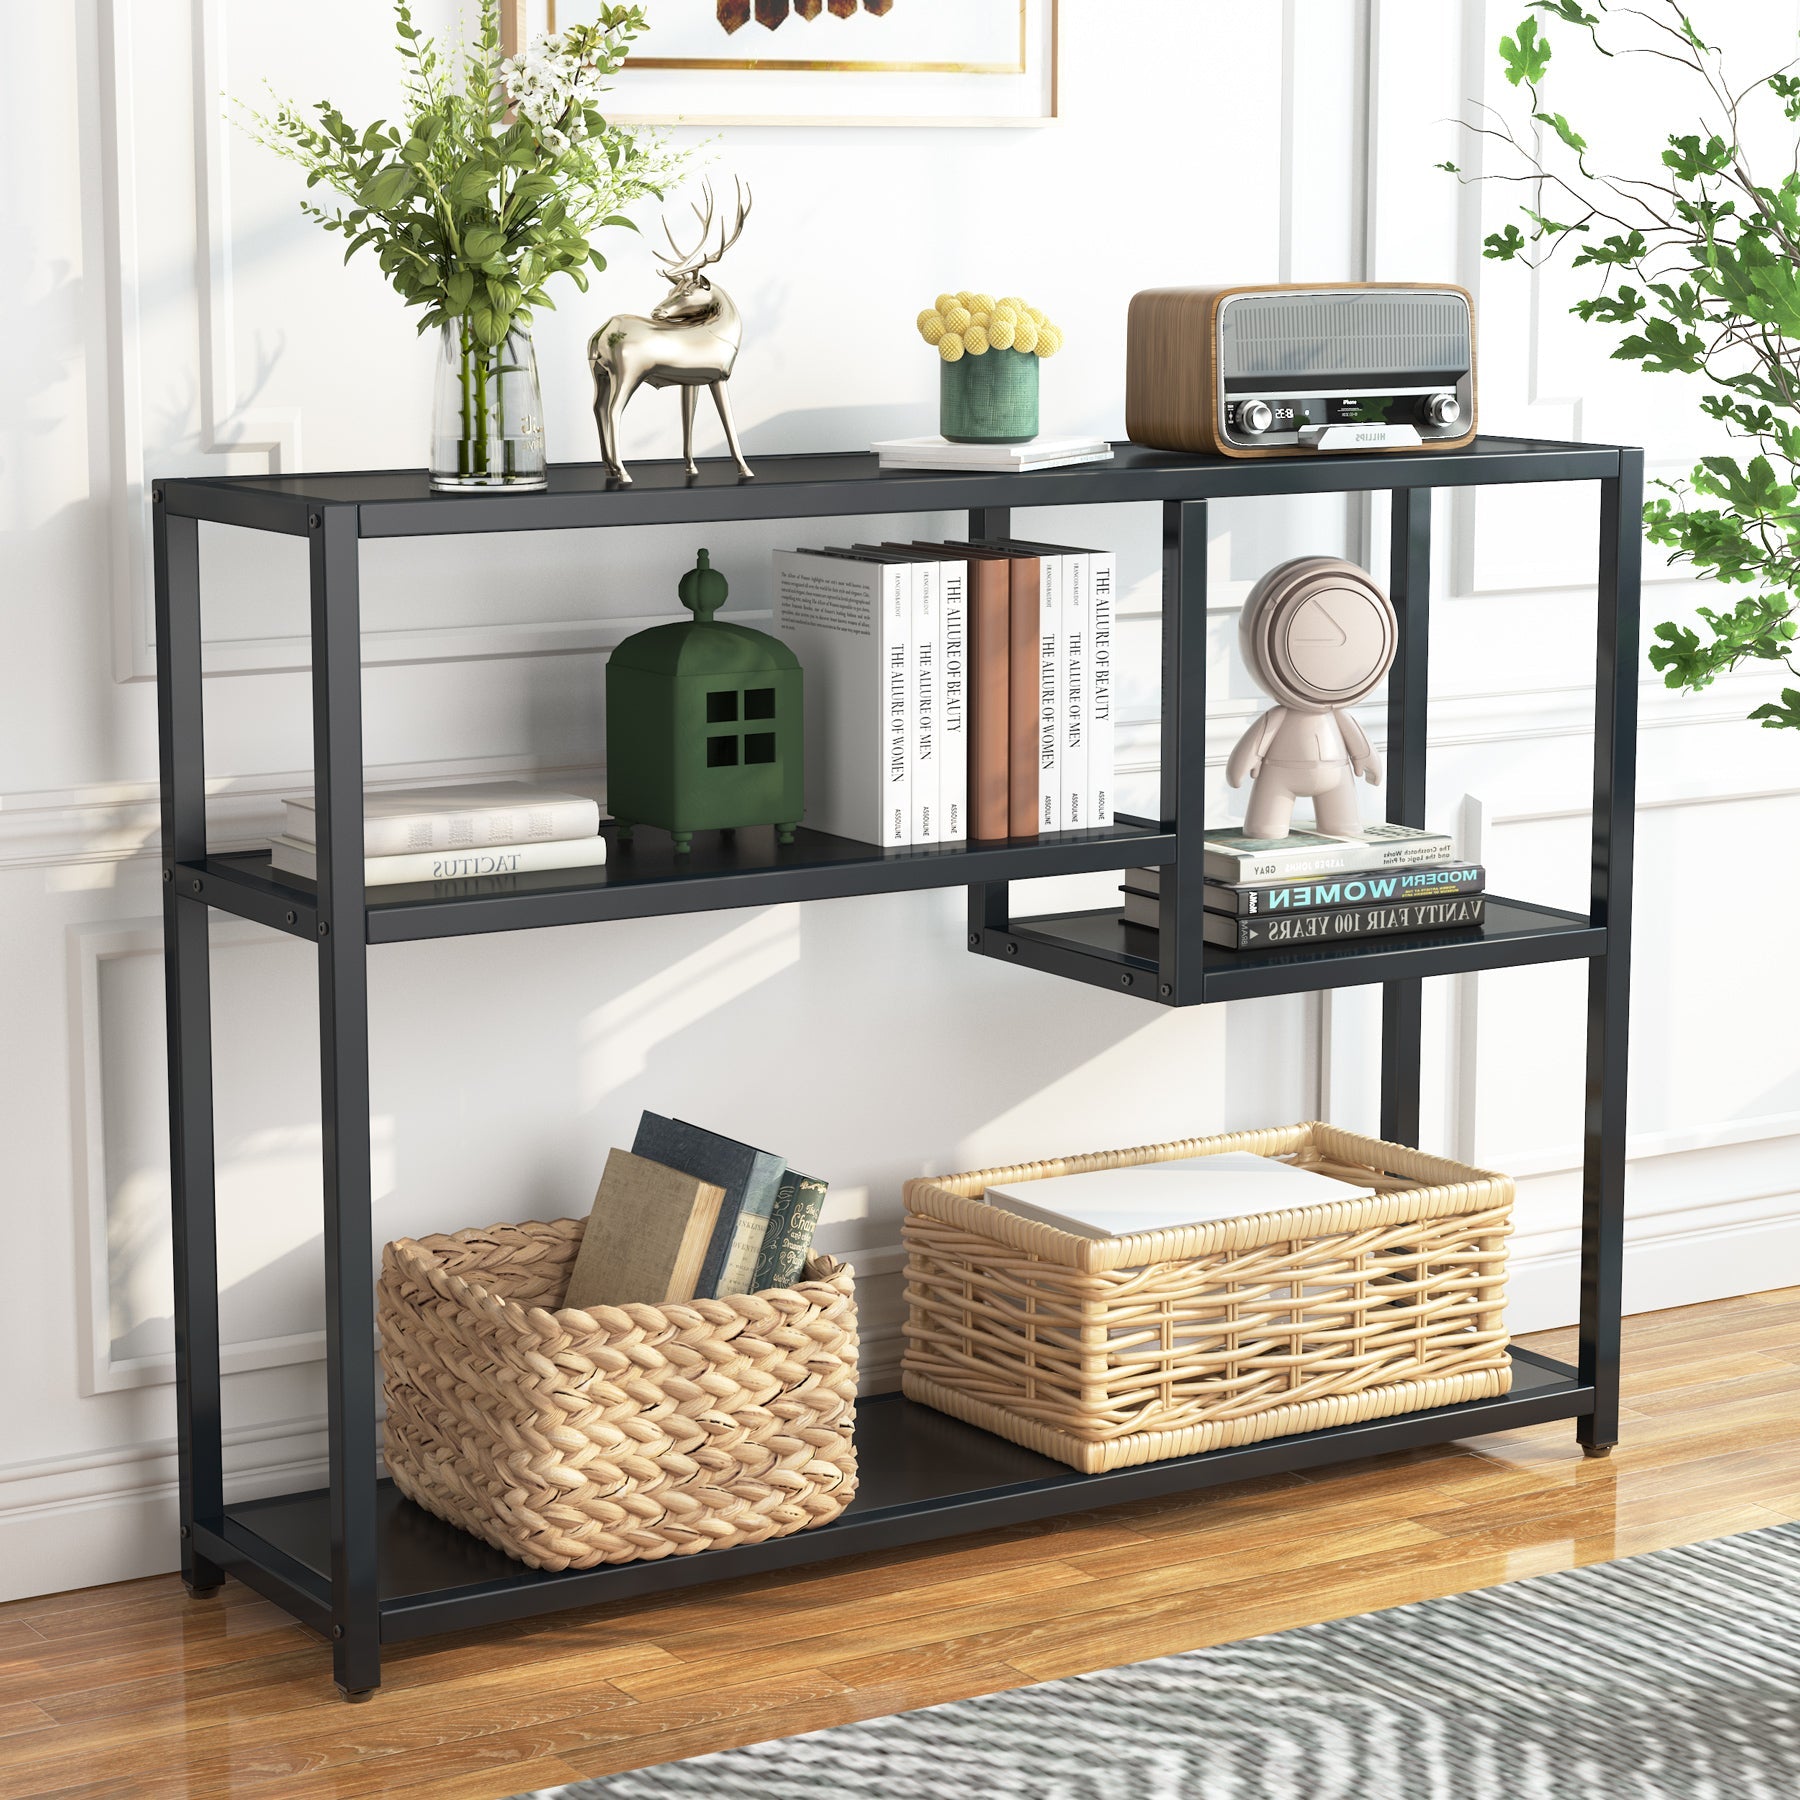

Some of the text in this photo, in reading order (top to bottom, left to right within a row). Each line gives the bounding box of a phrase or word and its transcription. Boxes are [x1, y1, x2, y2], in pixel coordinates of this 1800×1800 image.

[946, 576, 961, 732] THE ALLURE OF BEAUTY
[1095, 567, 1110, 721] THE ALLURE OF BEAUTY
[891, 643, 905, 782] THE ALLURE OF WOMEN
[919, 641, 932, 760] THE ALLURE OF MEN
[1041, 633, 1055, 770] THE ALLURE OF WOMEN
[1068, 631, 1082, 748] THE ALLURE OF MEN
[894, 808, 902, 839] ASSOULINE
[922, 806, 930, 836] ASSOULINE
[950, 803, 958, 834] ASSOULINE
[1044, 795, 1052, 825] ASSOULINE
[1071, 792, 1079, 822] ASSOULINE
[1098, 790, 1106, 820] ASSOULINE
